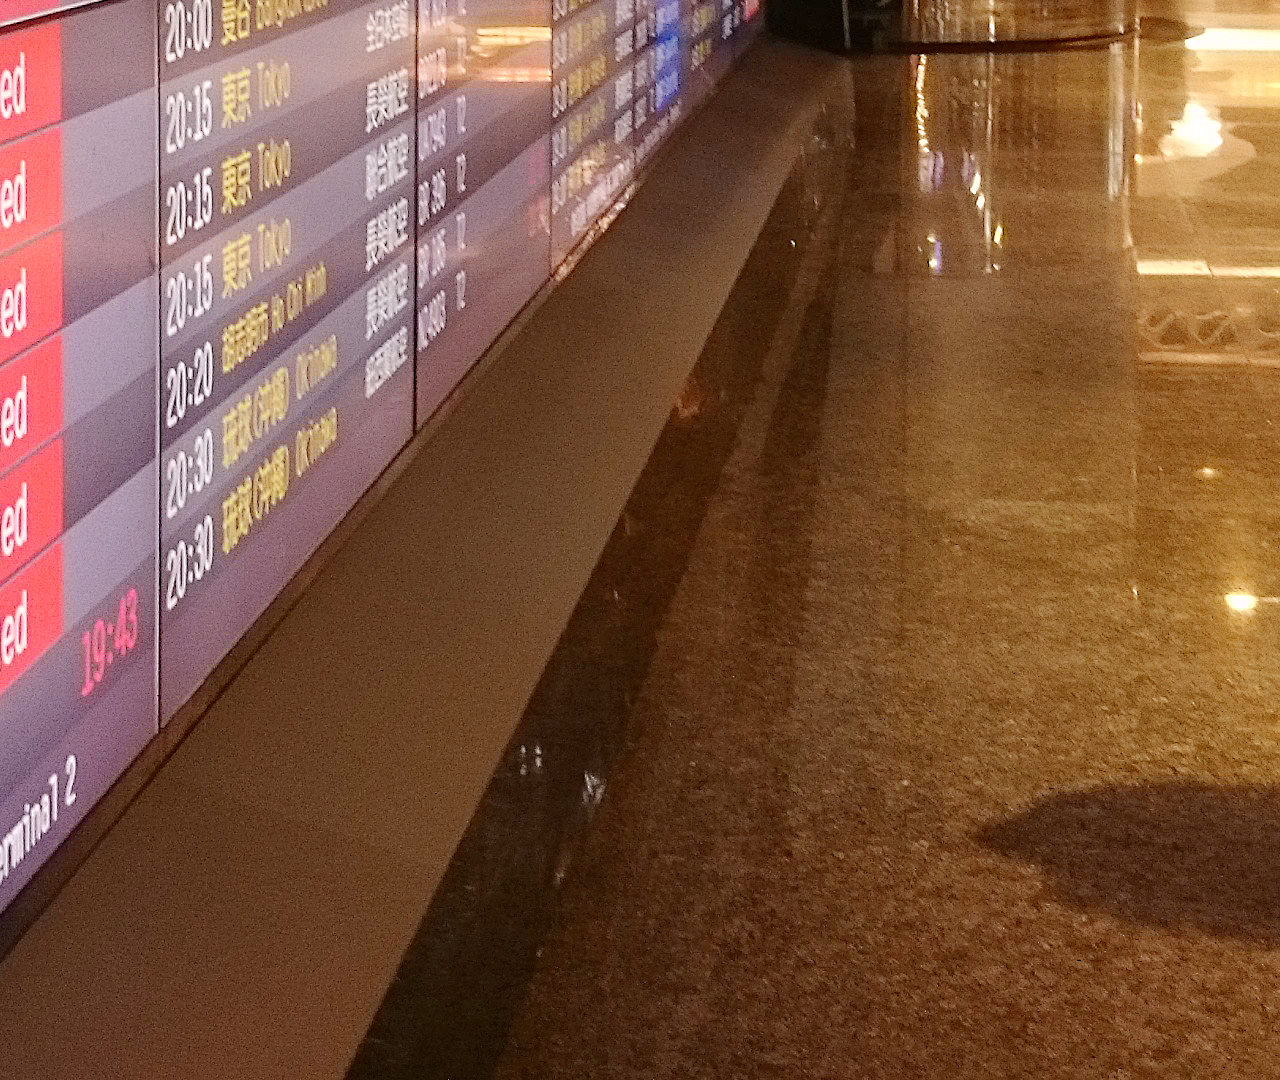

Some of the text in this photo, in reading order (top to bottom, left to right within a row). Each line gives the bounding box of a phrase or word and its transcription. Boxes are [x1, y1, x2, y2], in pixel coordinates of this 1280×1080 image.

[166, 80, 213, 154] 20:15
[257, 61, 291, 110] Tokyo
[166, 167, 213, 245] 20:15
[222, 149, 251, 214] 東京
[257, 138, 291, 191] Tokyo
[166, 254, 213, 337] 20:15
[257, 217, 291, 272] Tokyo
[167, 341, 213, 428] 20:20
[167, 428, 213, 519] 20:30
[167, 514, 213, 610] 20:30
[81, 587, 138, 697] 19:43
[65, 754, 77, 807] 2
